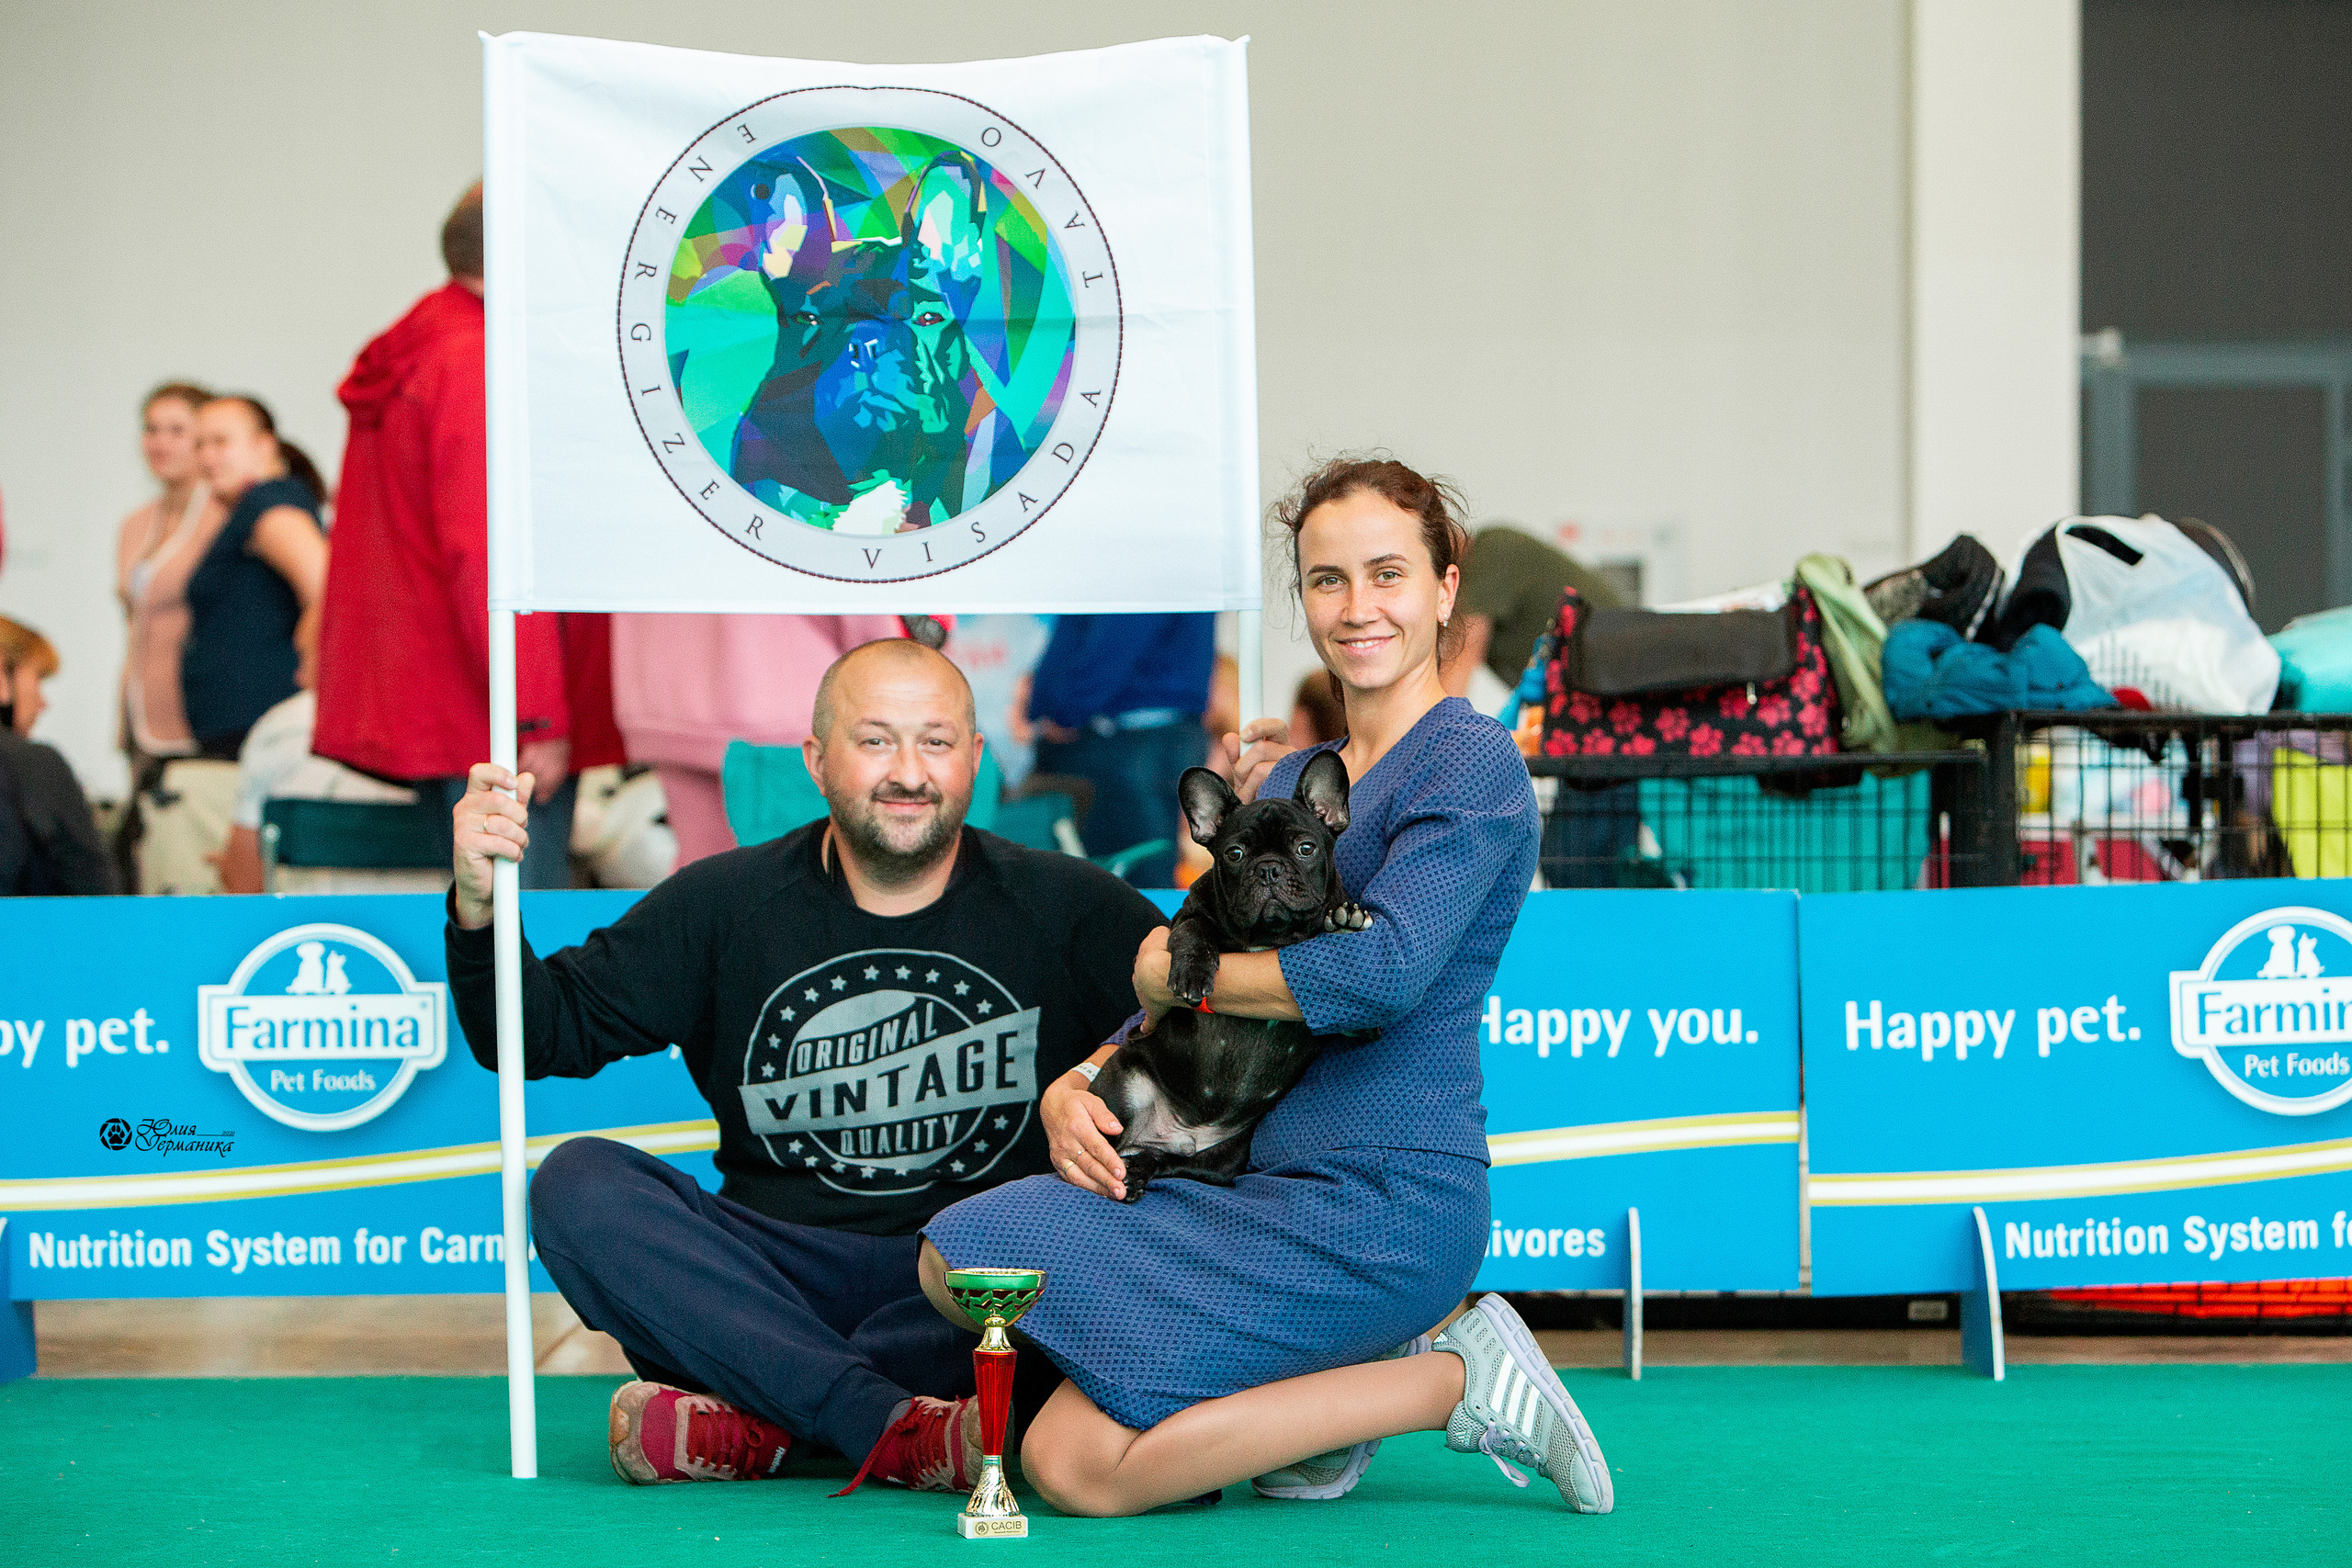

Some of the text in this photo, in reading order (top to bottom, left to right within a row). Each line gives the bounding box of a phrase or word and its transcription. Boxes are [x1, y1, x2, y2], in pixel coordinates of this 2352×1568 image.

[629, 122, 764, 541] ENERGIZER
[861, 387, 1102, 570] VISADA
[66, 1008, 169, 1068] pet.
[227, 1005, 419, 1048] Farmina
[796, 1001, 938, 1074] ORIGINAL
[1647, 1008, 1758, 1057] you.
[1845, 994, 2141, 1061] Happy pet.
[271, 1068, 376, 1091] Pet Foods
[763, 1031, 1019, 1121] VINTAGE
[2245, 1052, 2351, 1078] Pet Foods
[841, 1114, 959, 1156] QUALITY
[29, 1226, 537, 1274] Nutrition System for Carn
[1484, 1220, 1605, 1258] ivores
[2005, 1217, 2169, 1259] Nutrition
[2183, 1215, 2319, 1261] System
[991, 1521, 1022, 1530] CACIB
